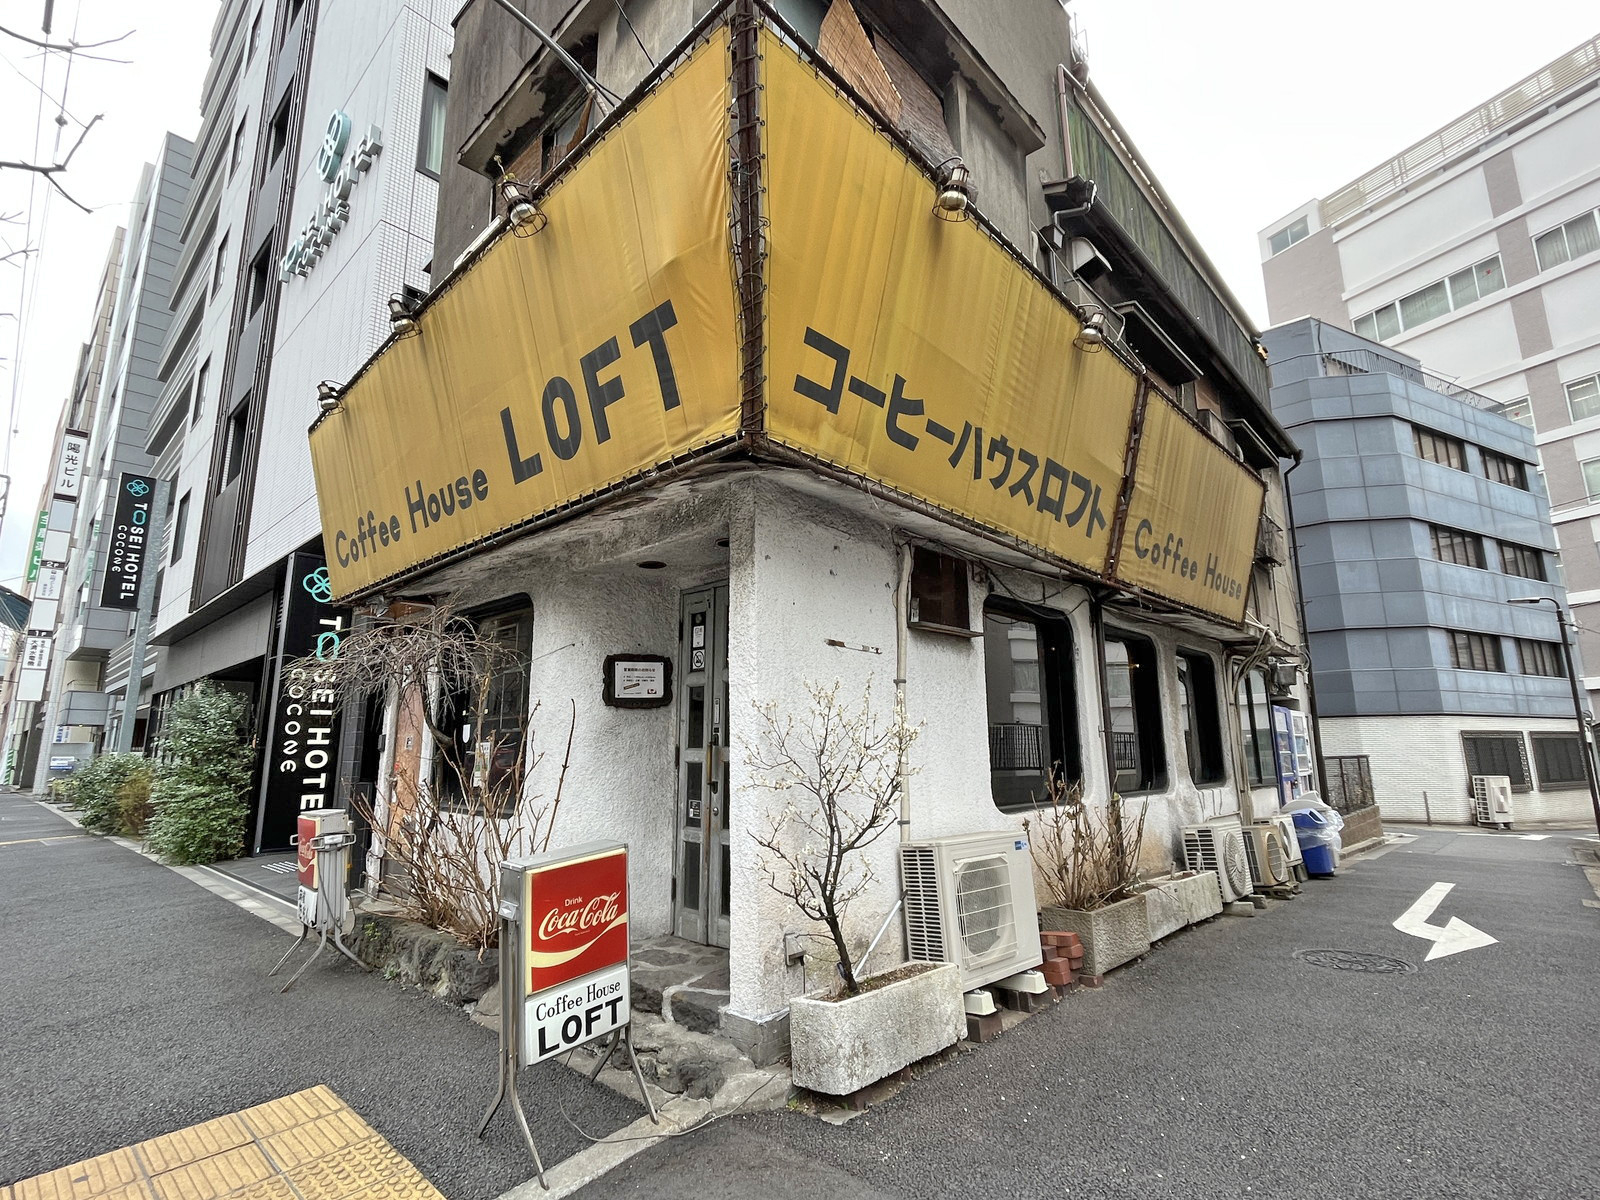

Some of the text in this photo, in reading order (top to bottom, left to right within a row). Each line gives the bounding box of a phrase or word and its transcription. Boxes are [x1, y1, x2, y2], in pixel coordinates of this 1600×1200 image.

[323, 123, 383, 217] HOTEL
[60, 442, 81, 488] 陽光ビル
[335, 299, 681, 568] Coffee House LOFT
[793, 326, 1107, 538] コーヒーハウスロフト
[112, 524, 128, 573] COCONE
[120, 503, 148, 600] TOSEI HOTEL
[1134, 518, 1242, 601] Coffee House
[300, 727, 331, 810] HOTE
[538, 890, 621, 940] Coca-Cola
[564, 896, 583, 907] Drink
[536, 980, 621, 1022] Coffee House
[538, 995, 624, 1057] LOFT
